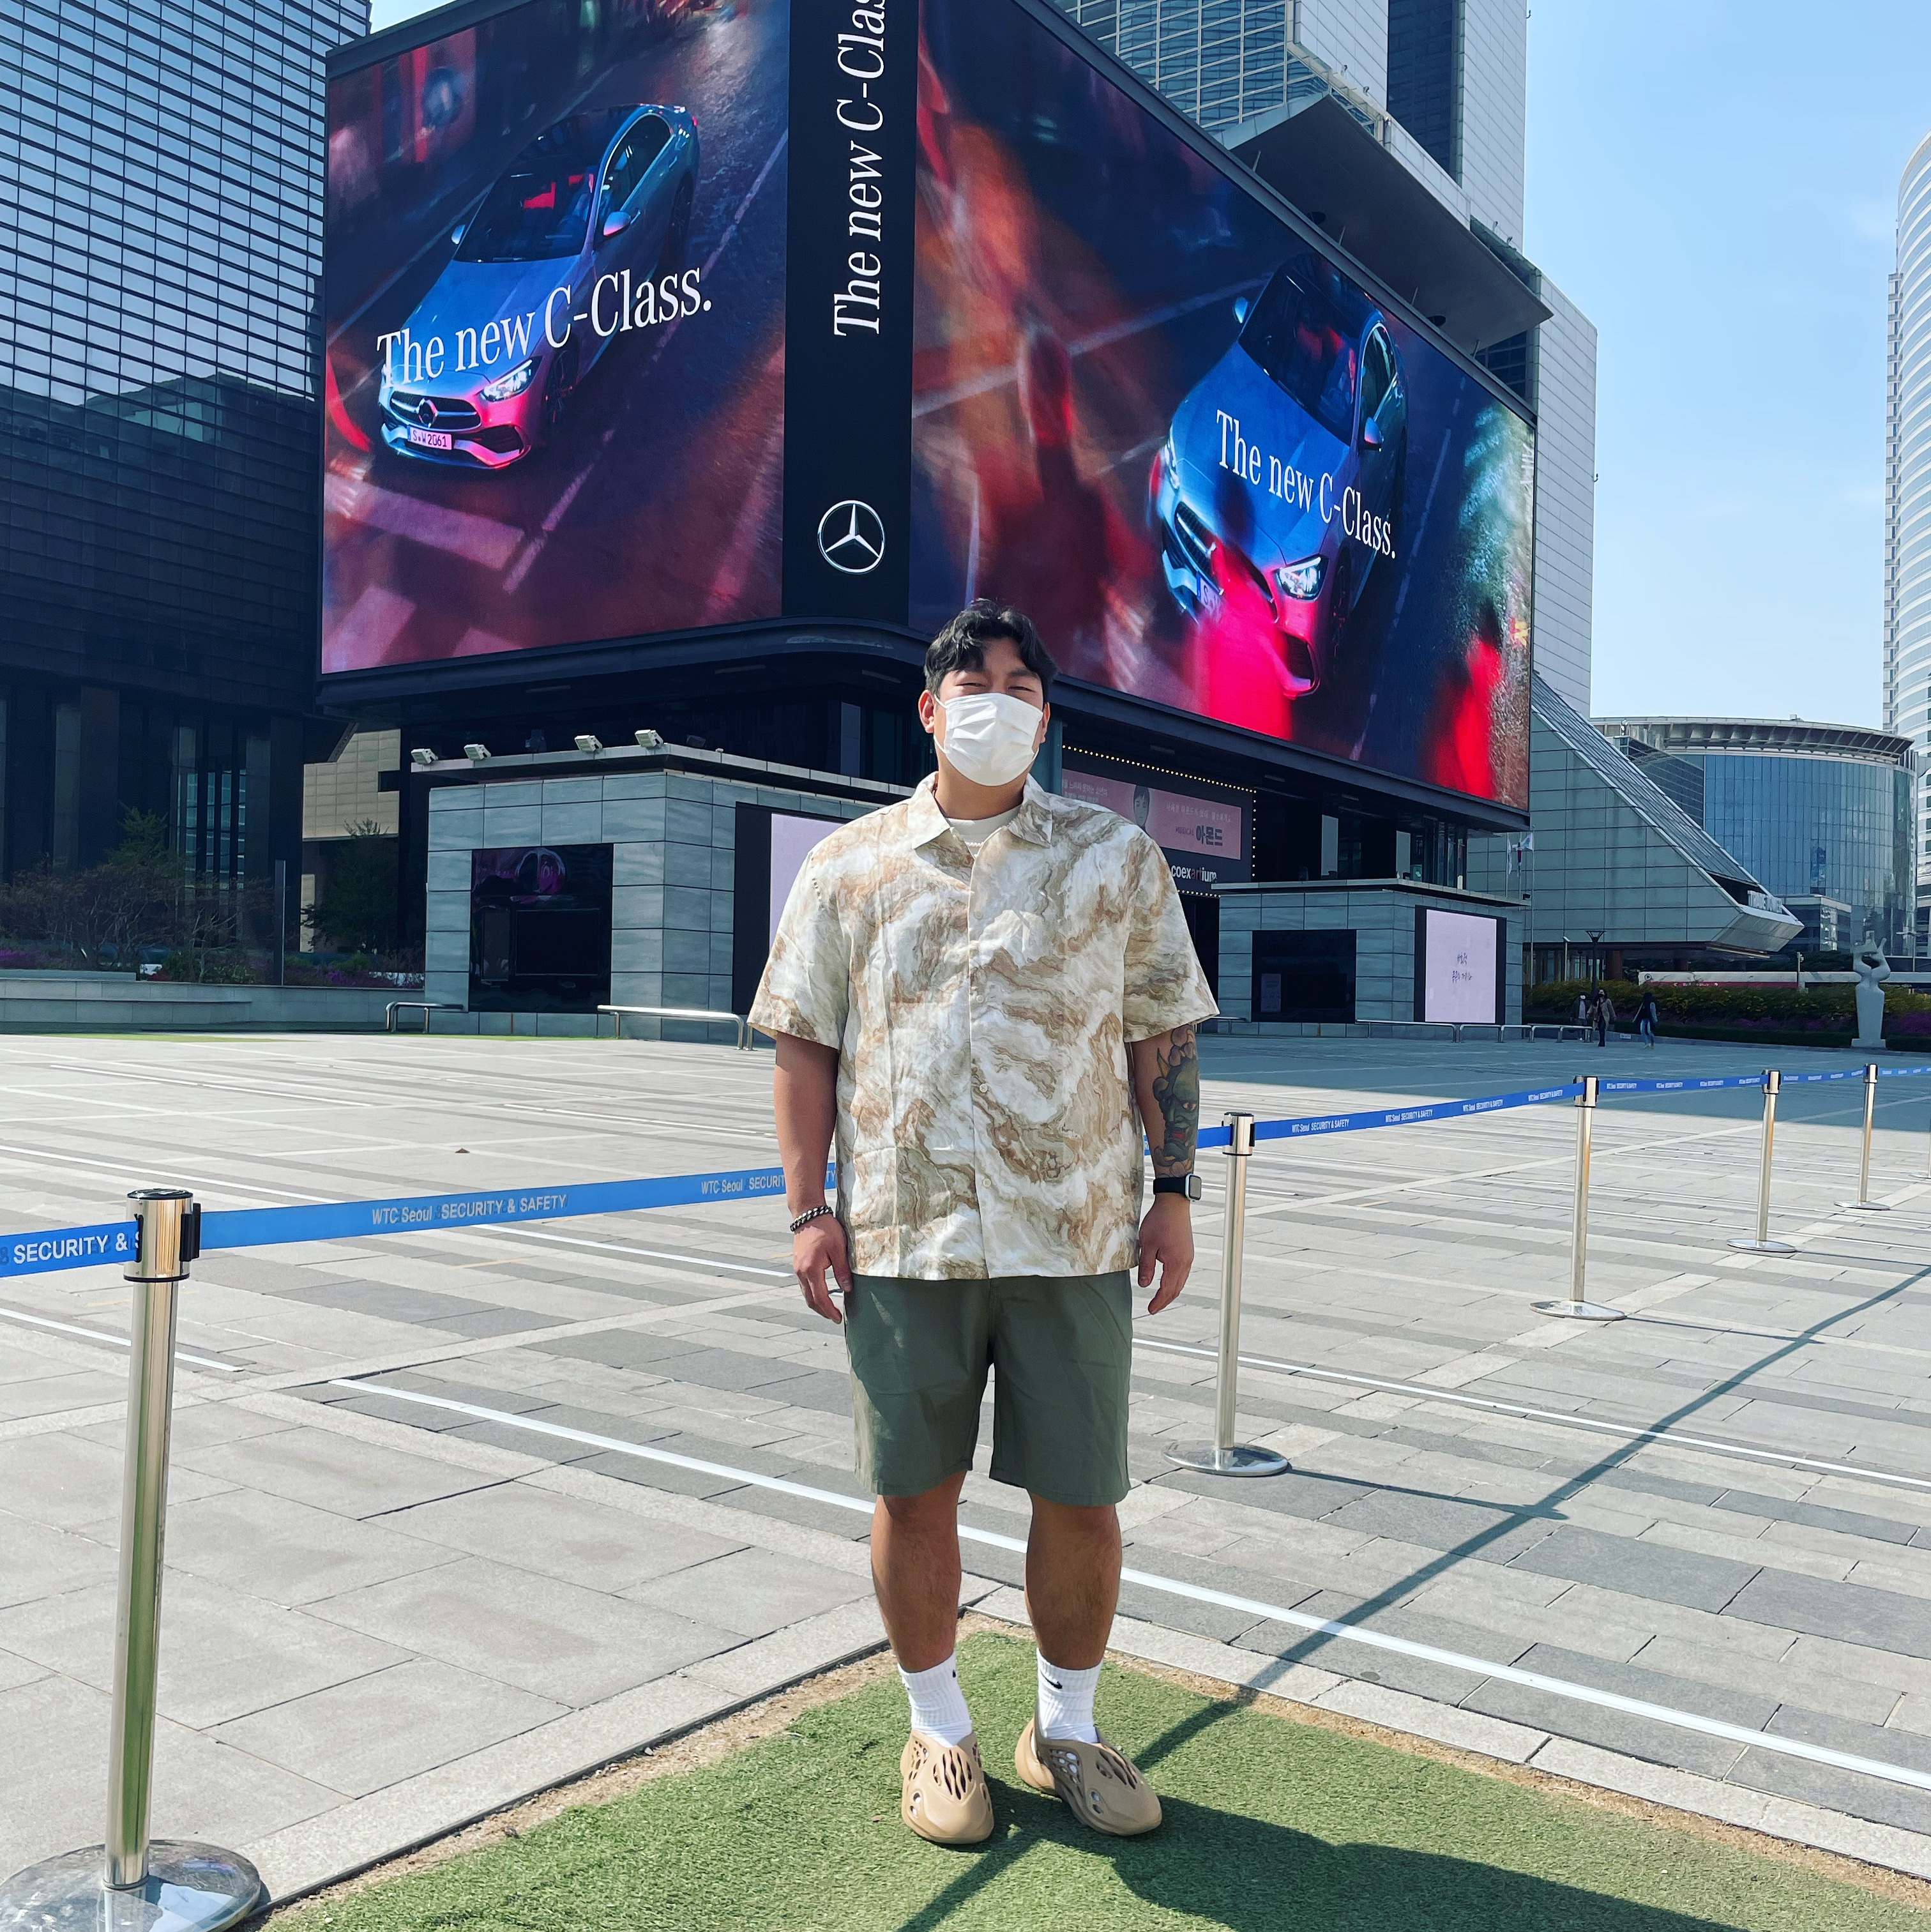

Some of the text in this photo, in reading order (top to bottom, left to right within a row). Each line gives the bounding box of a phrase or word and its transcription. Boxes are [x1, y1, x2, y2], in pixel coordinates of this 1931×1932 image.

[848, 140, 882, 241] new
[833, 252, 881, 337] The
[376, 267, 712, 389] The new C-Class.
[1216, 409, 1396, 559] The new C-Class.
[1196, 825, 1223, 846] 아몬드
[1311, 1120, 1331, 1130] SECURITY
[1334, 1118, 1349, 1128] SAFETY
[701, 1174, 785, 1194] WTC Seoul SECURIT
[372, 1194, 567, 1224] WTC Seoul SECURITY & SAFETY
[13, 1235, 109, 1264] SECURITY
[116, 1232, 128, 1252] &
